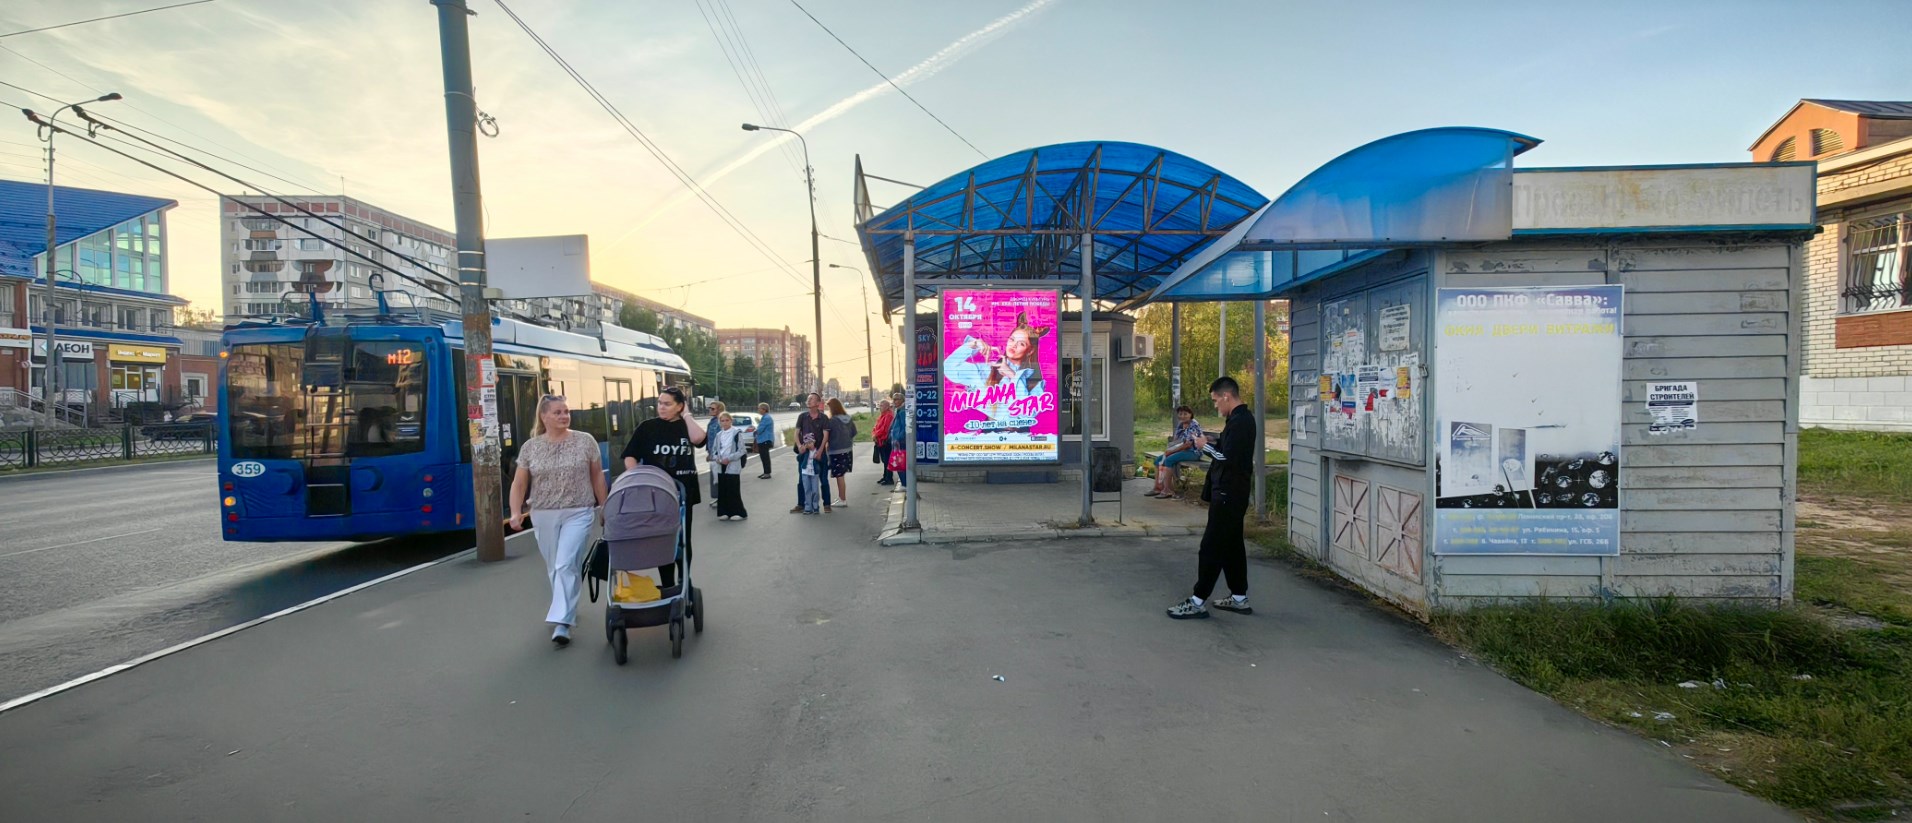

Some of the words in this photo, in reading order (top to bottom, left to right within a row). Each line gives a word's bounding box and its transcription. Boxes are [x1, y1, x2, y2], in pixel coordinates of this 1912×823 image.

[954, 296, 977, 312] 14
[1457, 294, 1487, 307] ООО
[1493, 294, 1529, 306] ПКФ
[1536, 293, 1608, 306] «Савва»:
[949, 382, 1017, 413] MILANA
[1650, 392, 1694, 400] СТРОИТЕЛЕЙ
[1007, 391, 1055, 417] STAR
[236, 463, 261, 474] 359
